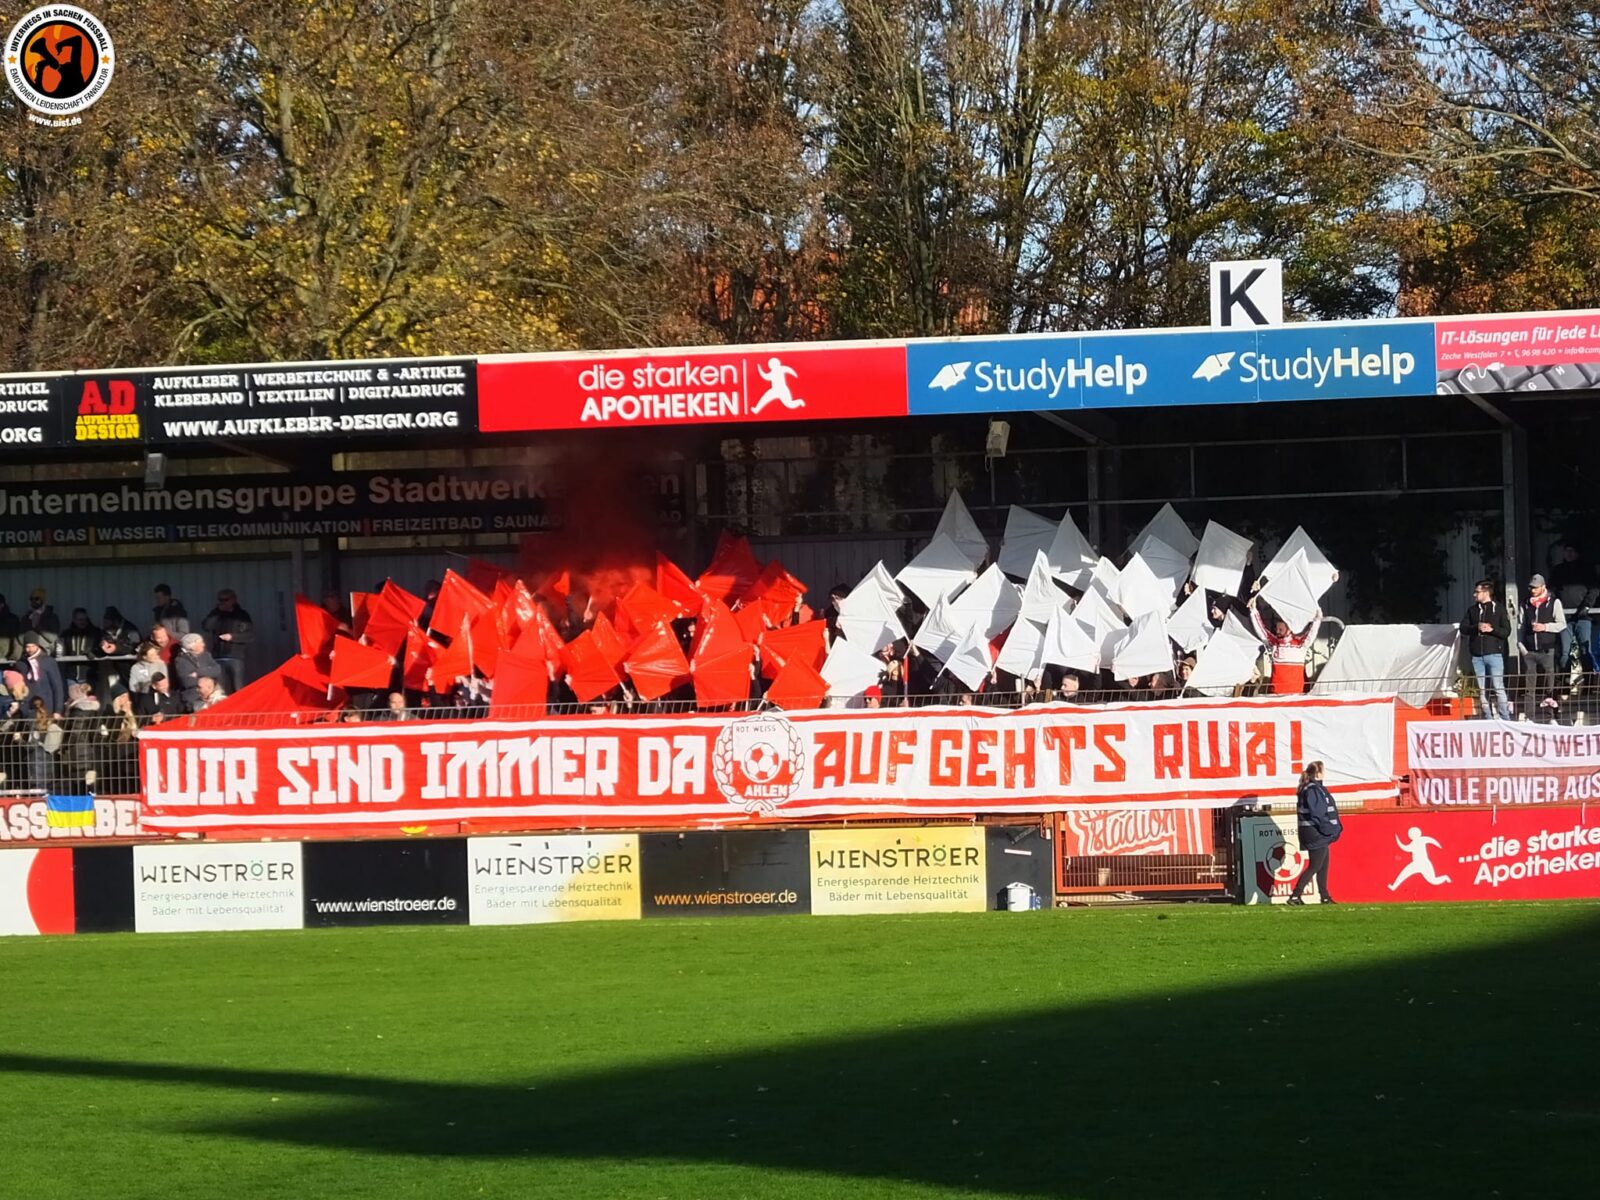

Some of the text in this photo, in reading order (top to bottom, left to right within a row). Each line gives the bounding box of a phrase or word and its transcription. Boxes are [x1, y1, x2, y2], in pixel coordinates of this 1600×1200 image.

[1219, 268, 1271, 327] K
[1440, 330, 1528, 346] IT-Lösungen
[1531, 327, 1553, 344] für
[1554, 325, 1586, 343] jede
[152, 366, 466, 390] AUFKLEBER WERBETECHNIK & -ARTIKEL
[578, 360, 738, 391] die starken
[974, 355, 1148, 398] StudyHelp
[1239, 345, 1415, 388] StudyHelp
[78, 379, 136, 415] AD
[153, 383, 465, 408] KLEBEBAND TEXTILIEN DIGITALDRUCK
[580, 391, 739, 421] APOTHEKEN
[75, 423, 140, 440] DESIGN
[76, 414, 138, 425] AUFKLEBER
[163, 411, 459, 438] WWW.AUFKLEBER-DESIGN.ORG
[368, 473, 566, 504] Stadtwerk
[53, 528, 87, 543] GAS
[97, 526, 166, 541] WASSER
[176, 519, 361, 539] TELEKOMMUNIKATION
[372, 517, 483, 532] FREIZEITBAD
[753, 725, 777, 733] WEISS
[812, 729, 918, 789] AUF
[928, 723, 1127, 789] GEHTS
[1415, 731, 1600, 759] KEIN WEG ZU WEIT
[146, 735, 706, 806] WIR SIND IMMER DA
[744, 784, 788, 797] AHLEN
[1416, 777, 1480, 805] VOLLE
[1486, 775, 1559, 804] POWER
[1258, 829, 1273, 837] ROT
[1458, 825, 1600, 863] ...die starke
[474, 852, 632, 876] WIENSTRÖER
[816, 844, 979, 869] WIENSTRÖER
[140, 859, 295, 883] WIENSTRÖER
[817, 874, 980, 889] Energiesparende Heiztechnik
[140, 888, 295, 903] Energiesparende Heiztechnik
[474, 881, 633, 895] Energiesparende Heiztechnik
[654, 889, 797, 906] www.wienstroeer.de
[829, 889, 968, 902] Bäder mit Lebensqualität
[1269, 881, 1314, 896] AHLN
[186, 904, 204, 915] mit
[315, 896, 456, 913] www.wienstroeer.de
[520, 898, 538, 908] mit
[542, 896, 622, 910] Lebensqualität
